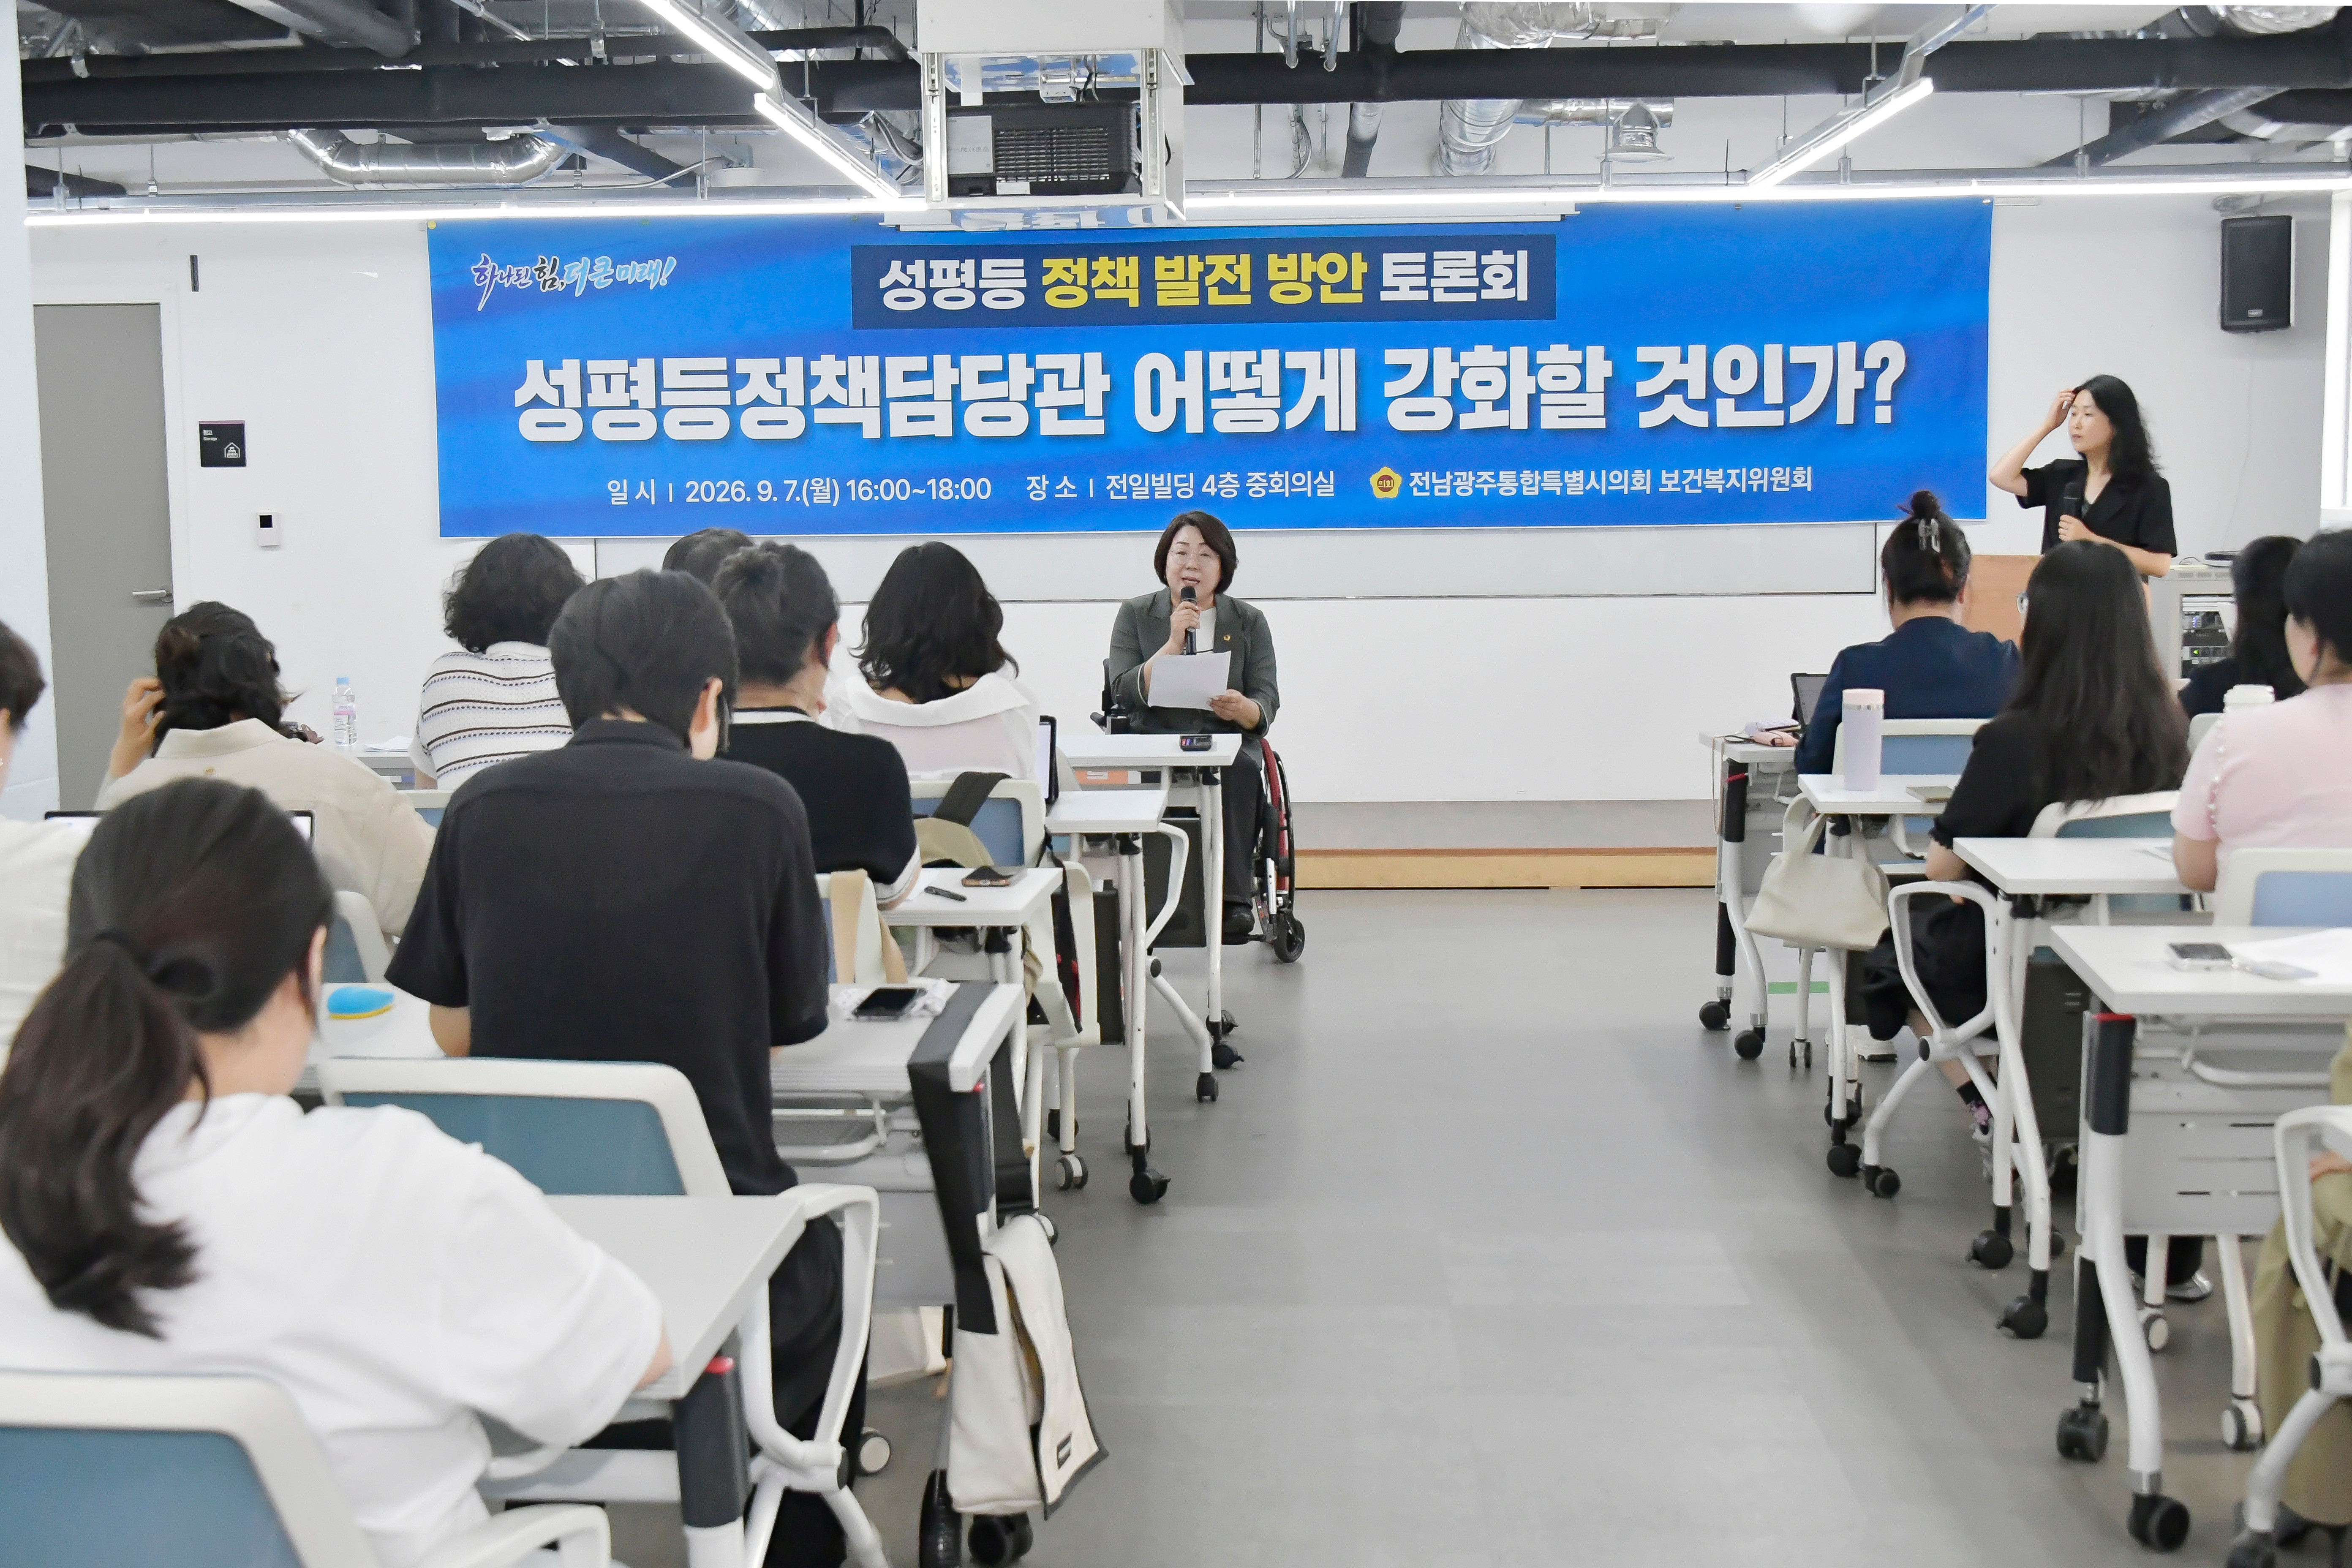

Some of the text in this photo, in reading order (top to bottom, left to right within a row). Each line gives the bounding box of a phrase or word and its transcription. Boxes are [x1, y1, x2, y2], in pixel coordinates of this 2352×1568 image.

[471, 253, 533, 311] 하나된
[589, 255, 615, 289] 큰
[616, 256, 677, 290] 미래!
[880, 250, 1527, 311] 성평등 정책 발전 방안 토론회
[514, 340, 1906, 441] 성평등정책담당관 어떻게 강화할 것인가?
[686, 480, 751, 502] 2026.
[757, 480, 778, 502] 9.
[784, 477, 839, 507] 7.(월)
[847, 477, 991, 501] 16:00~18:00
[1106, 472, 1194, 499] 전일빌딩
[1202, 472, 1240, 498] 4층
[1246, 471, 1334, 498] 중회의실
[1409, 466, 1811, 496] 전남광주통합특별시의회 보건복지위원회
